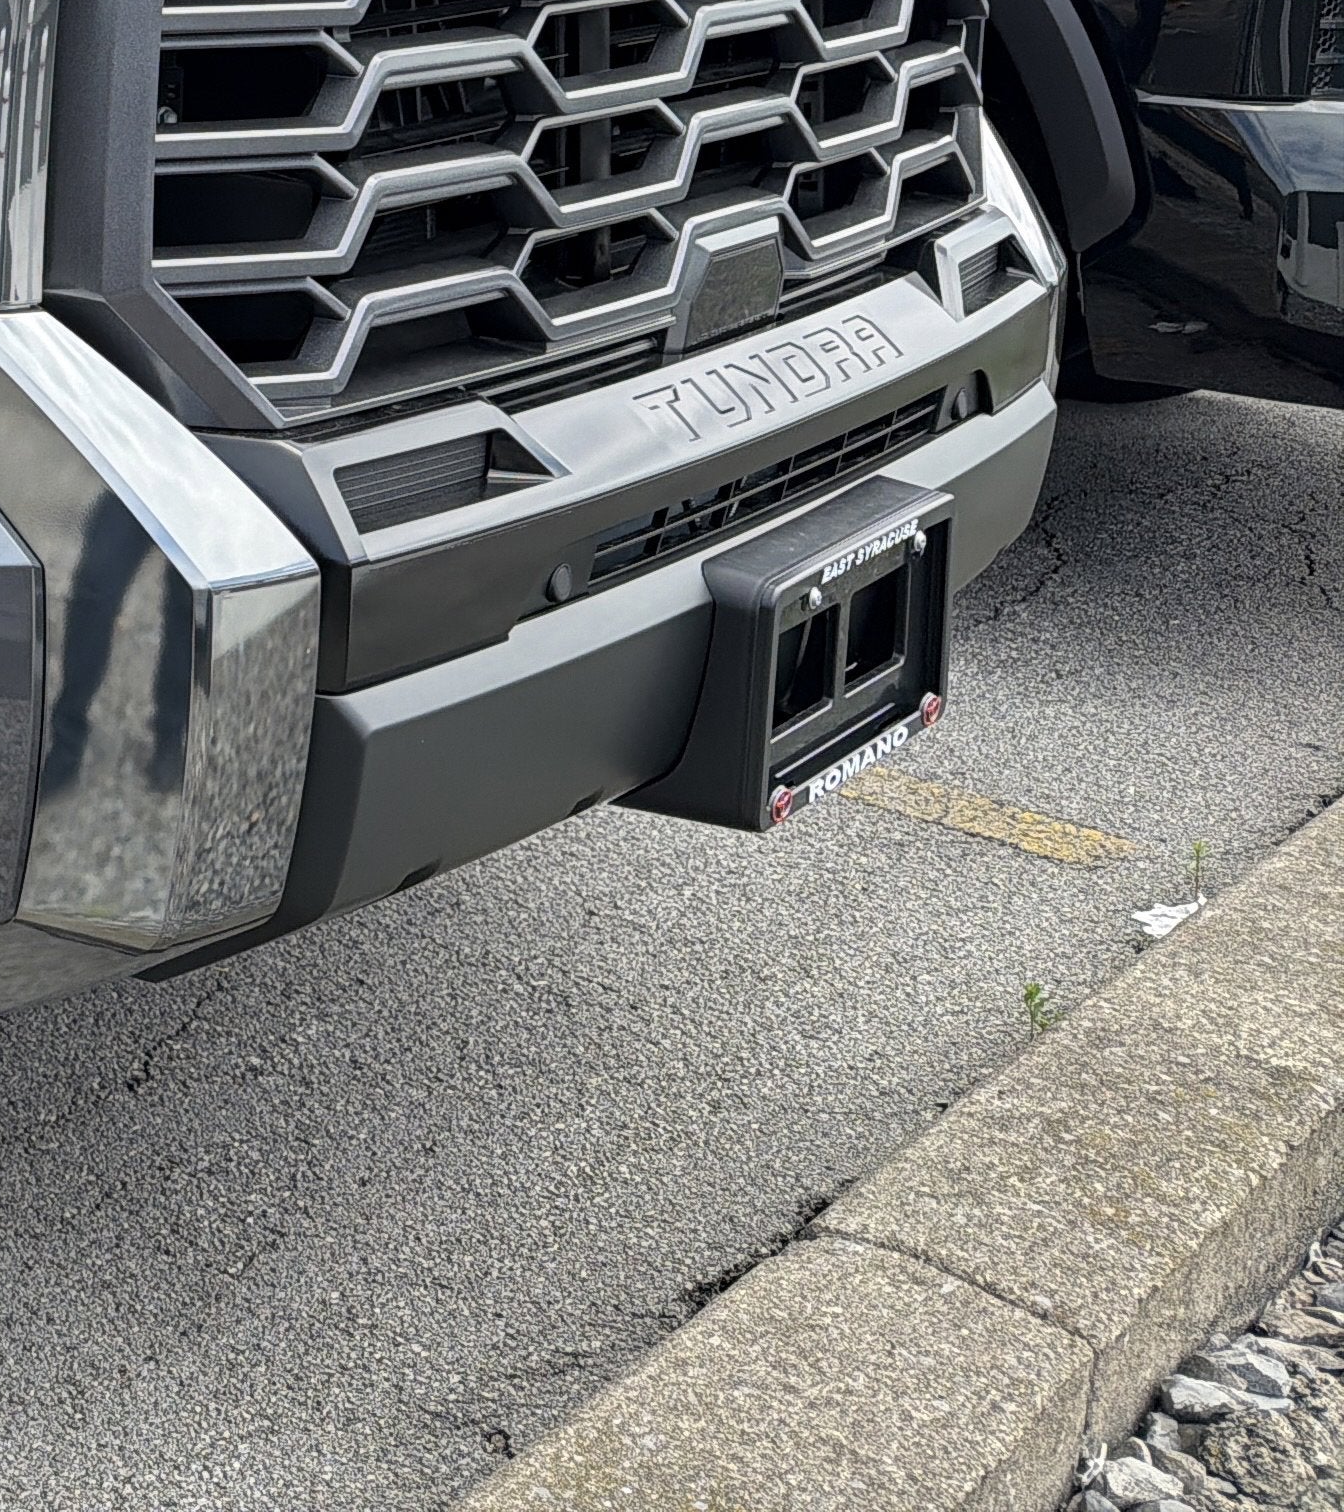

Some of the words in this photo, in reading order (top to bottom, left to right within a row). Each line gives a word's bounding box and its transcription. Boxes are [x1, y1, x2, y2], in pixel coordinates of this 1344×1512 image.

[632, 314, 905, 442] TUNDRA
[821, 551, 855, 585] EAST
[855, 518, 919, 566] SYRACUSE
[808, 725, 909, 804] ROMANO
